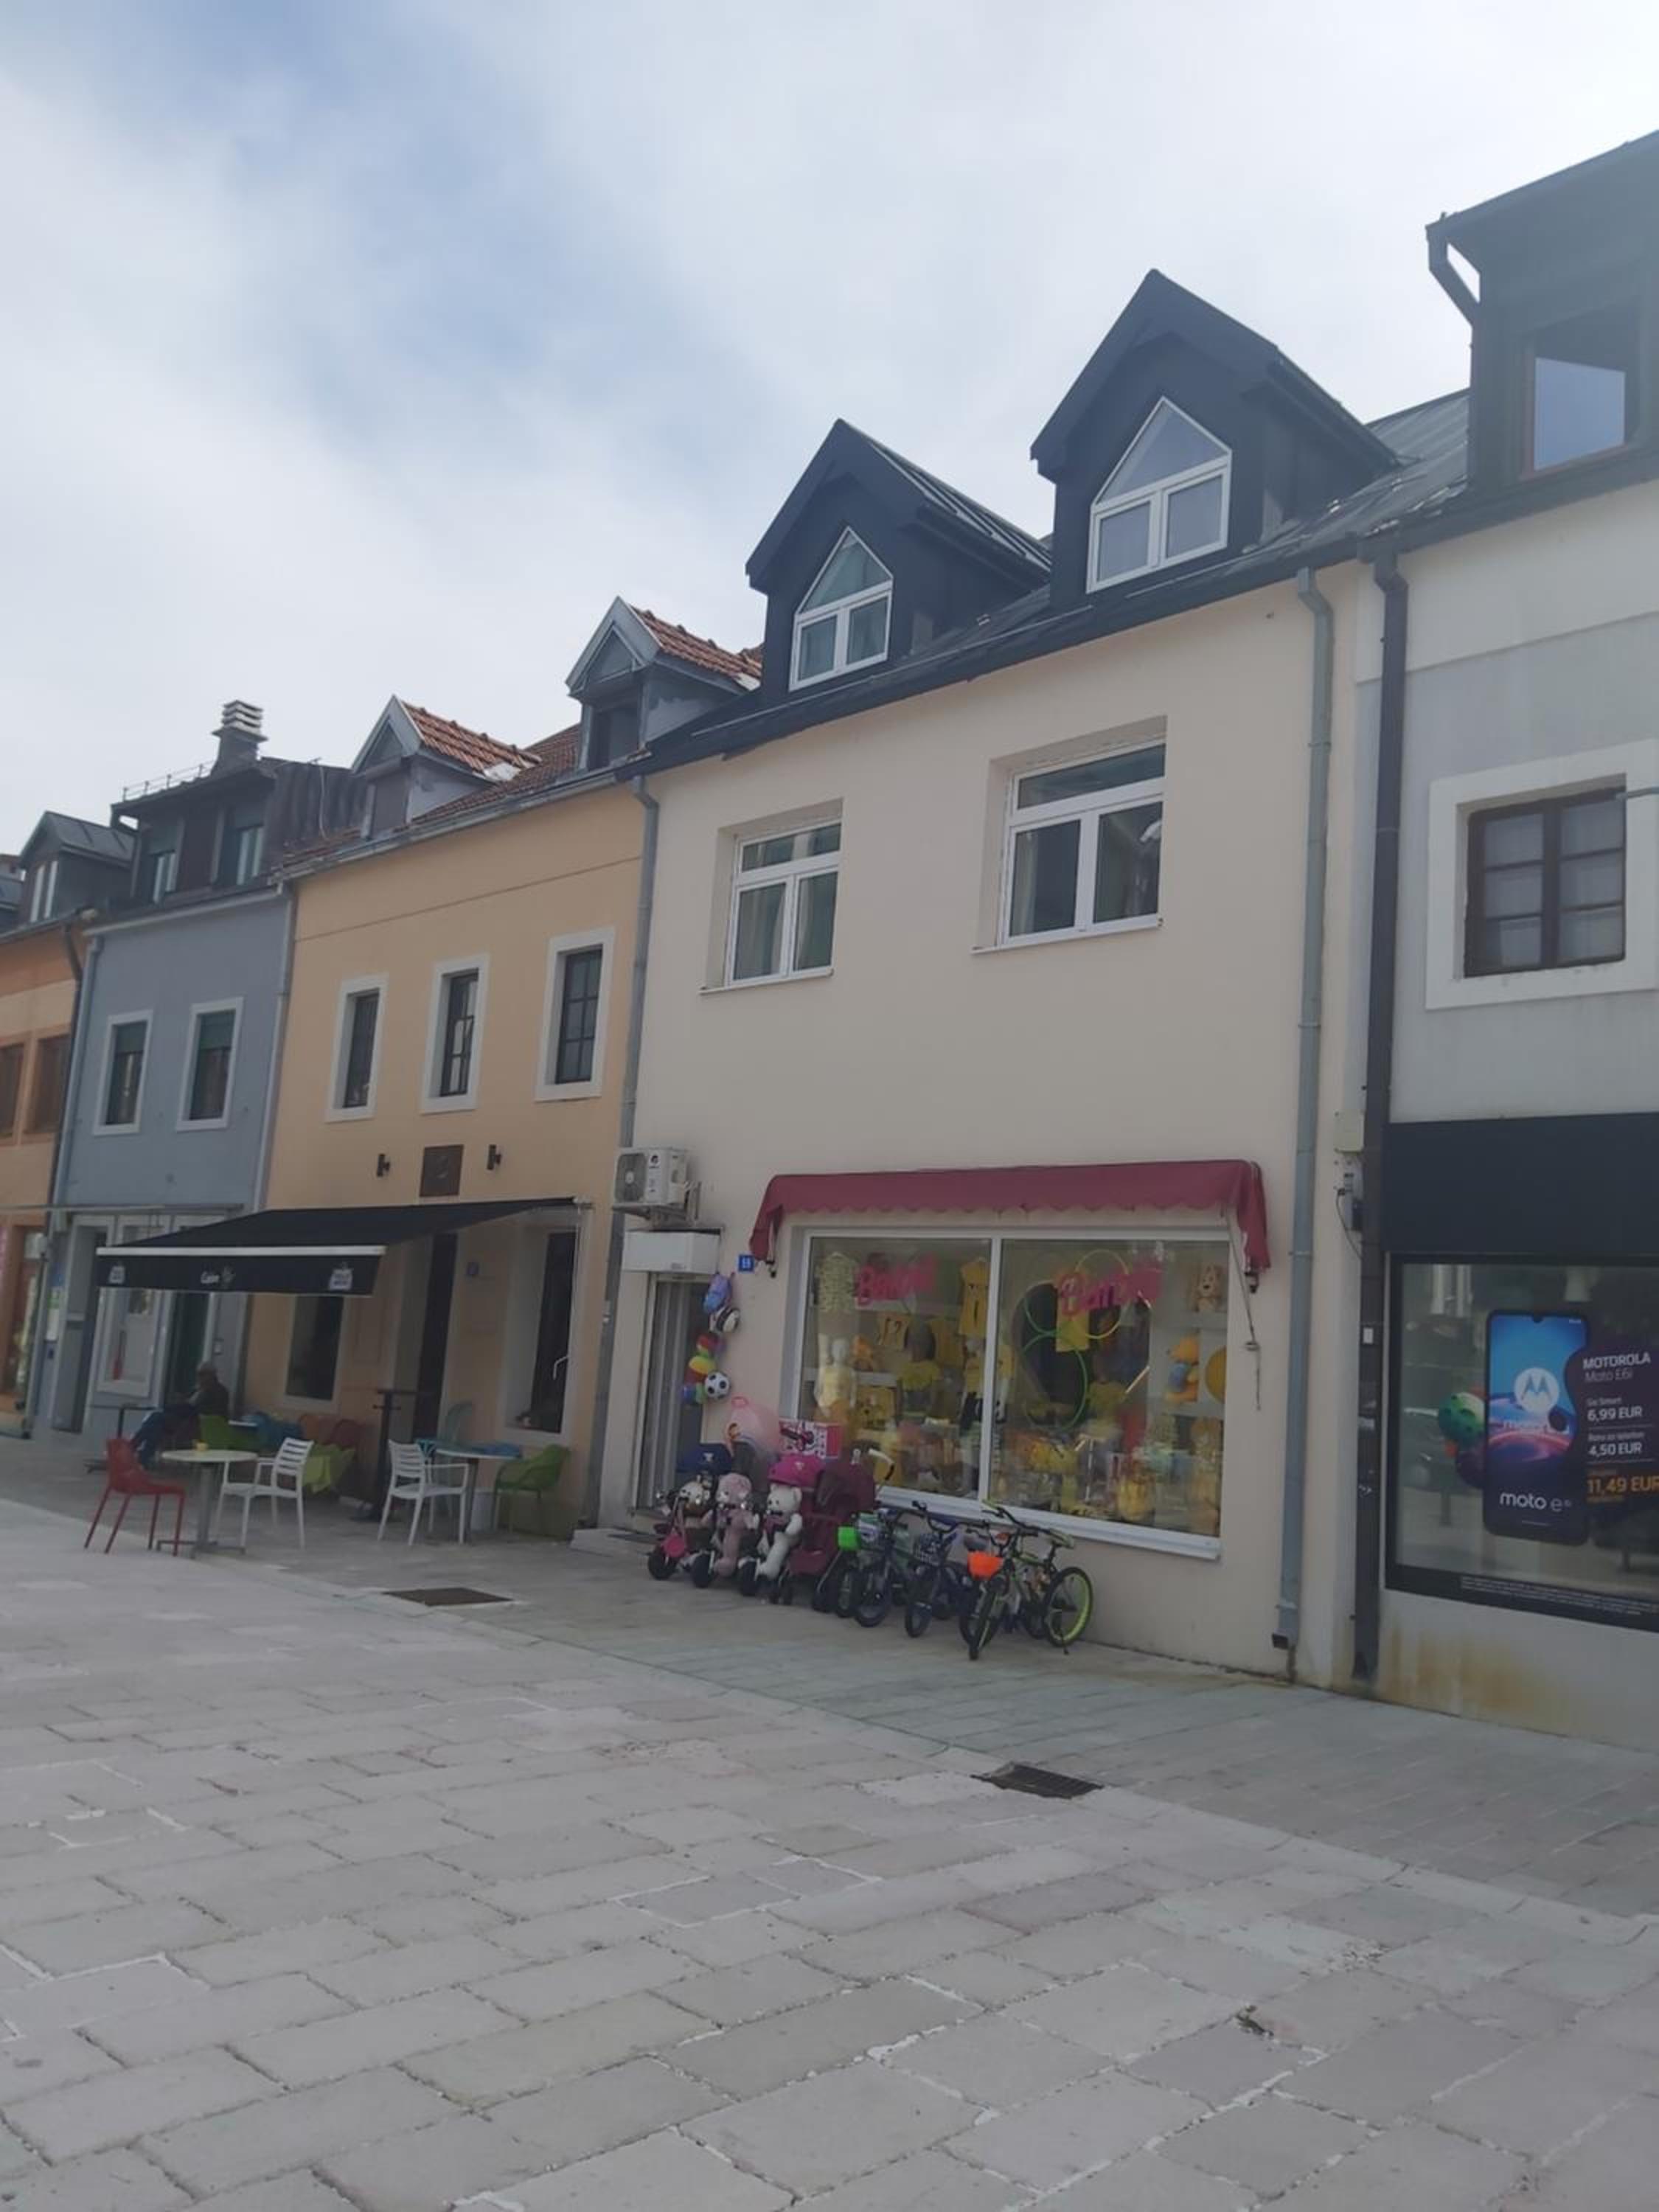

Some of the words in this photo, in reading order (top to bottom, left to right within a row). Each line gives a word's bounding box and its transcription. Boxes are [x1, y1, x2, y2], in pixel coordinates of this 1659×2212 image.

[1583, 1352, 1651, 1369] MOTOROLA
[1587, 1408, 1616, 1422] 6,99
[1618, 1405, 1643, 1419] EUR
[1589, 1443, 1616, 1458] 4,50
[1618, 1441, 1642, 1455] EUR
[1587, 1477, 1627, 1497] 11,49
[1630, 1475, 1659, 1492] EUR
[1500, 1492, 1547, 1510] moto
